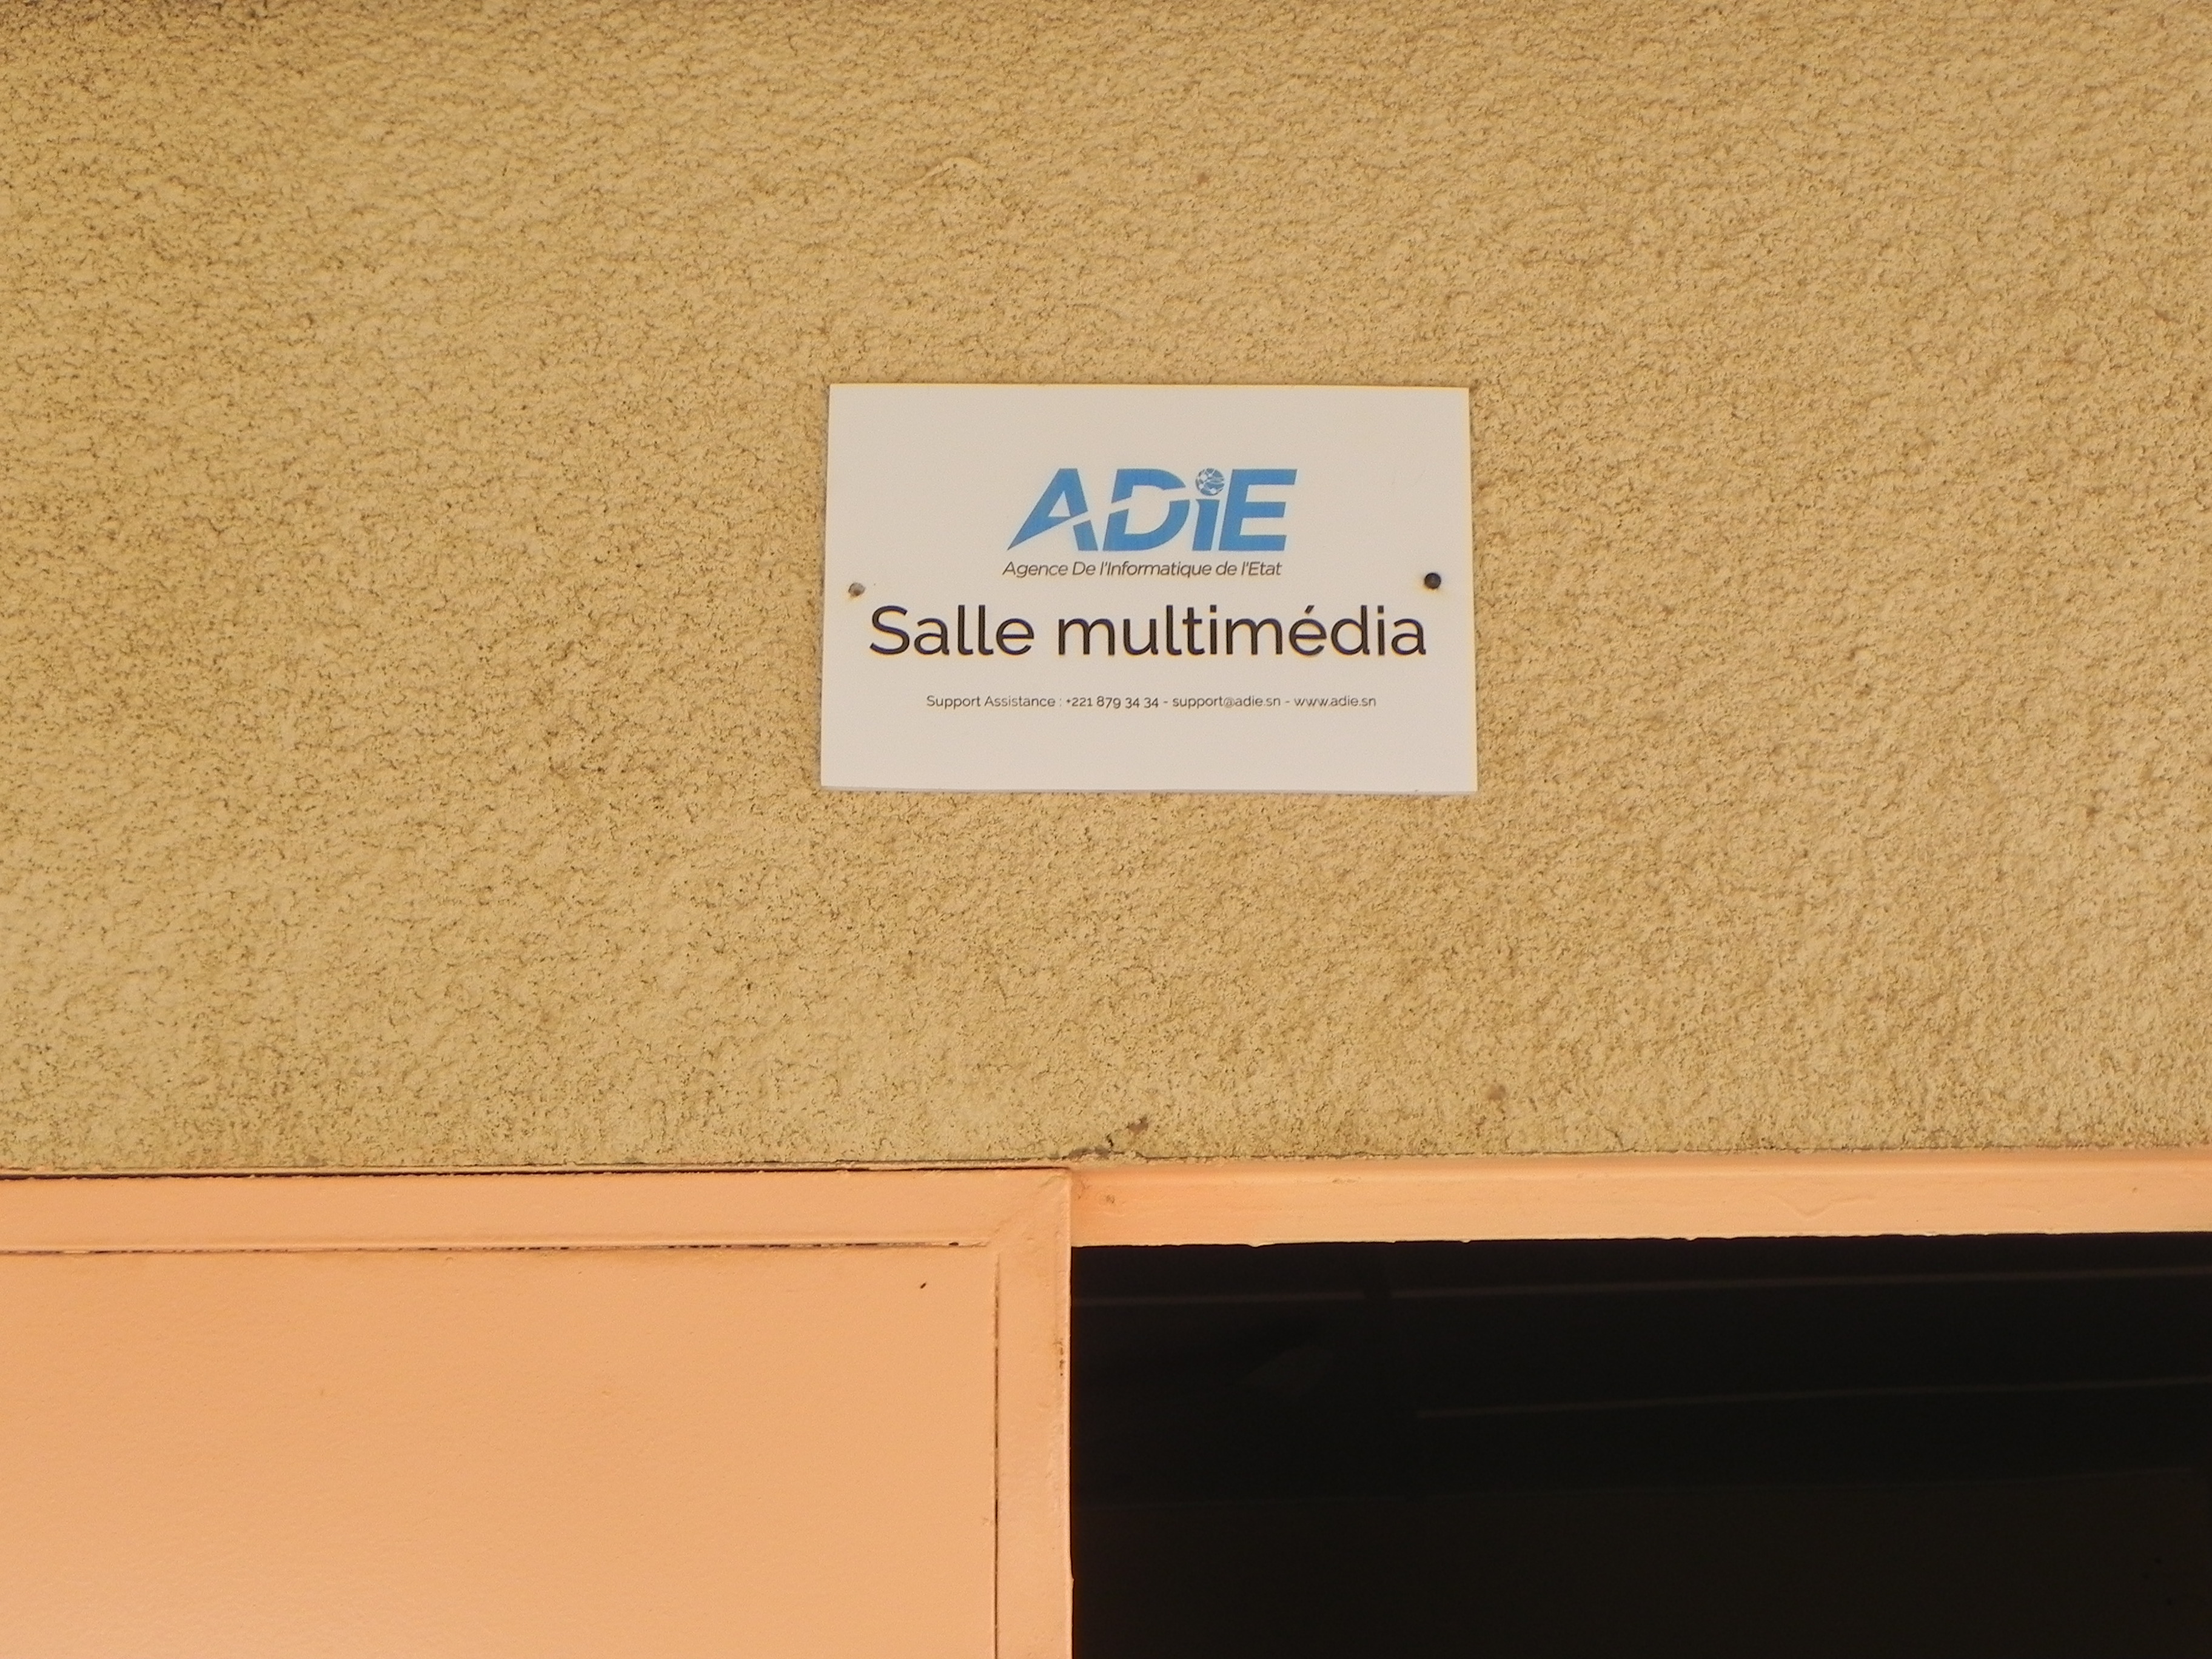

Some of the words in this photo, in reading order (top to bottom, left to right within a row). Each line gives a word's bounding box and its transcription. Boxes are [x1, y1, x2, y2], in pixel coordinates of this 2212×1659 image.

[1002, 560, 1068, 579] Agence
[1072, 560, 1096, 577] De
[1215, 560, 1238, 577] de
[869, 604, 1034, 656] Salle
[1058, 604, 1427, 657] multimédia
[927, 695, 981, 711] Support
[984, 695, 1056, 708] Assistance
[1066, 696, 1093, 708] +221
[1096, 695, 1121, 709] 879
[1125, 697, 1140, 709] 34
[1144, 697, 1159, 709] 34
[1172, 695, 1281, 710] support@adie.sn
[1293, 695, 1376, 708] www.adie.sn
